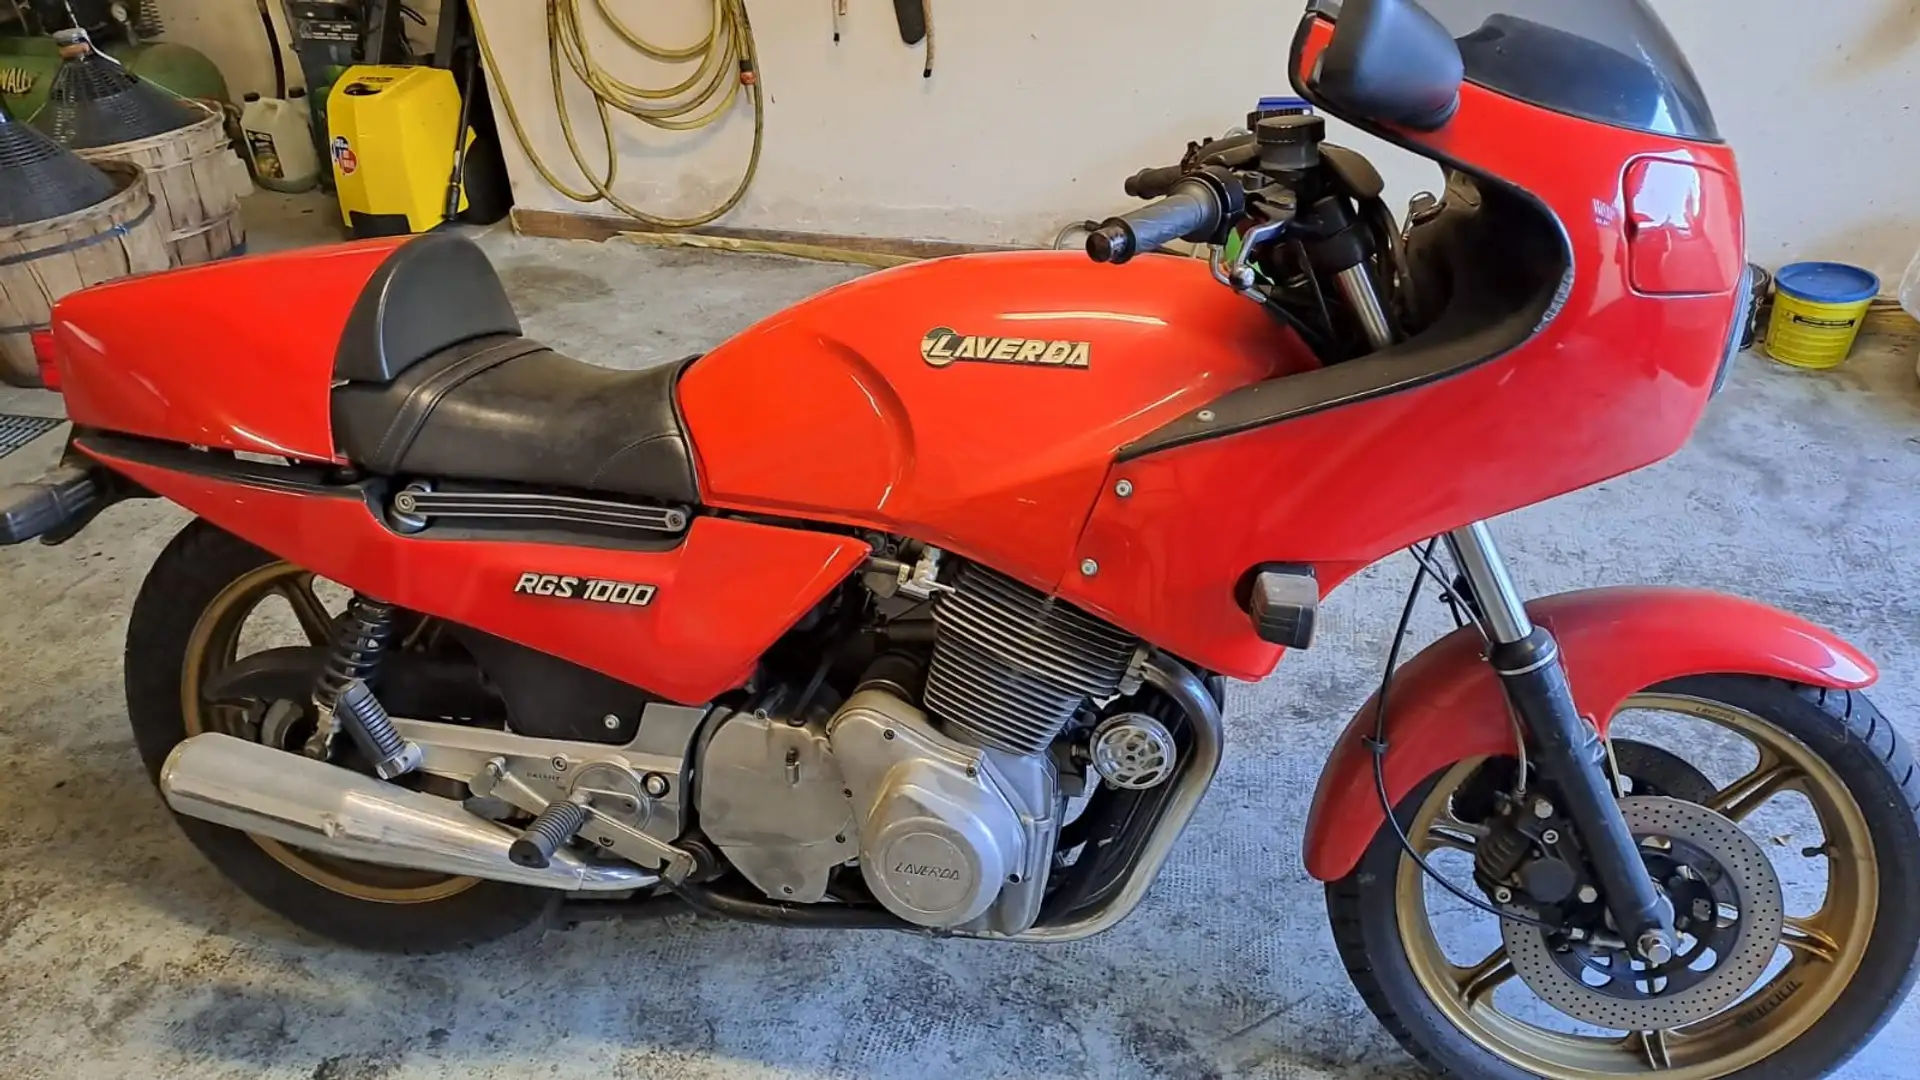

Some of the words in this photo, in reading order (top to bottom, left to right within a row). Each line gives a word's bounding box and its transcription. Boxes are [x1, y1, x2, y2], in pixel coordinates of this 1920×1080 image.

[927, 333, 1091, 367] LAVERDA
[514, 572, 579, 598] RGS
[582, 579, 657, 606] 1000
[894, 861, 960, 881] LAVERDA
